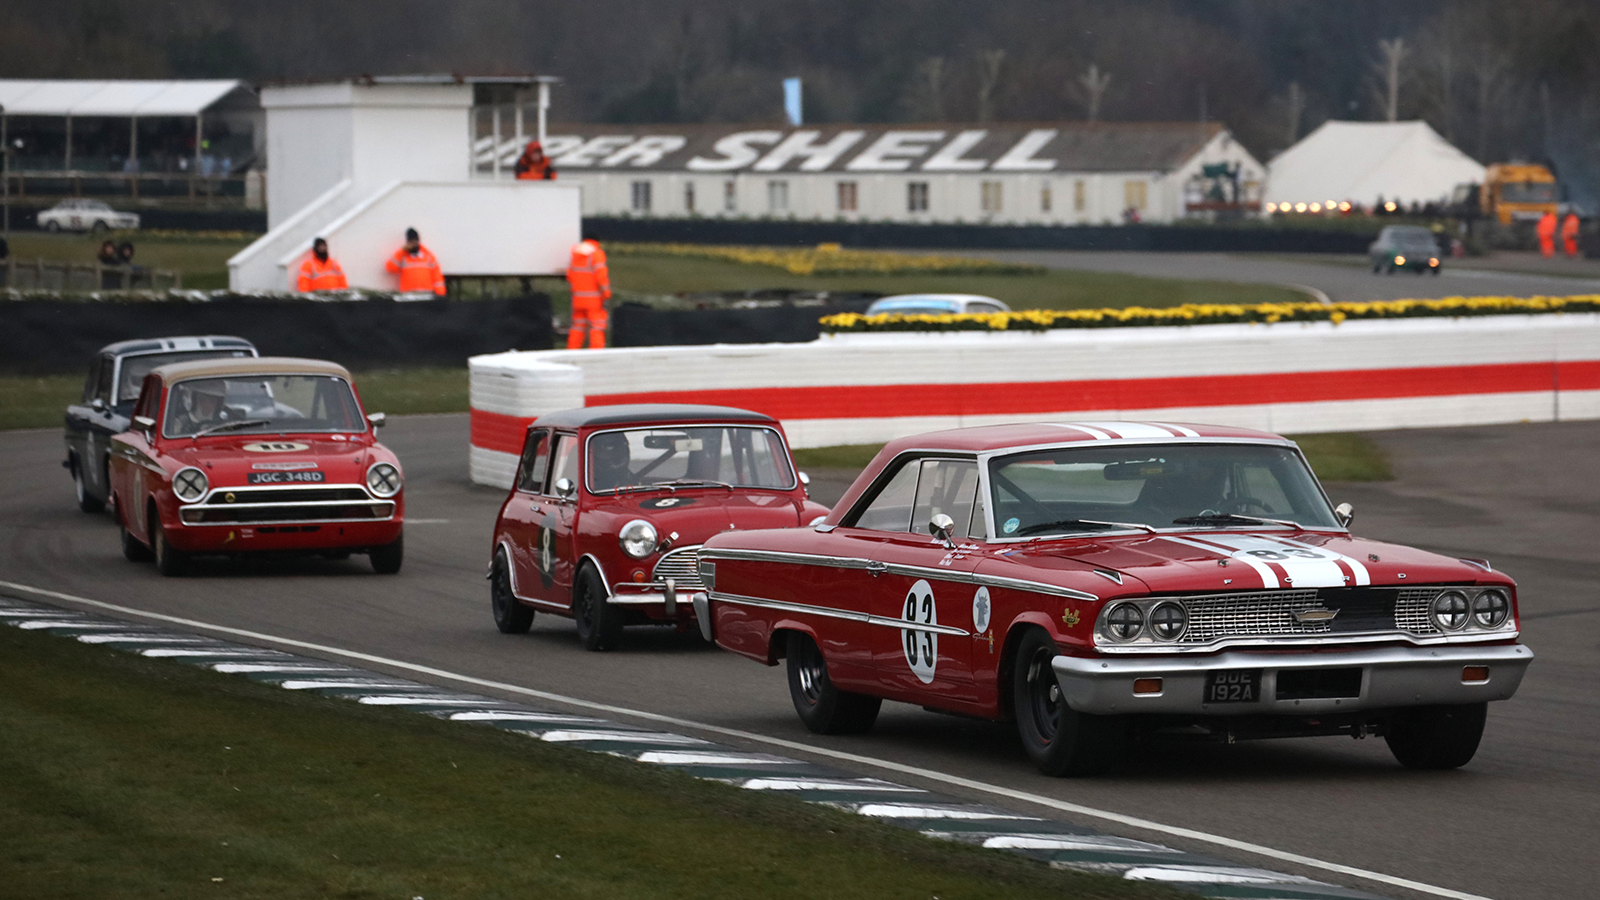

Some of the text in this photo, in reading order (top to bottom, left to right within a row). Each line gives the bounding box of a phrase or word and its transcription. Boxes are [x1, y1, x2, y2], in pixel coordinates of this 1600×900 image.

[687, 129, 1058, 171] SHELL
[260, 443, 296, 451] 10
[253, 472, 322, 483] JGC 348D
[654, 498, 680, 507] 8
[542, 526, 551, 573] 8
[1246, 548, 1327, 561] 83
[1223, 573, 1407, 585] FORD
[906, 592, 934, 668] 83
[1211, 684, 1253, 701] 192A
